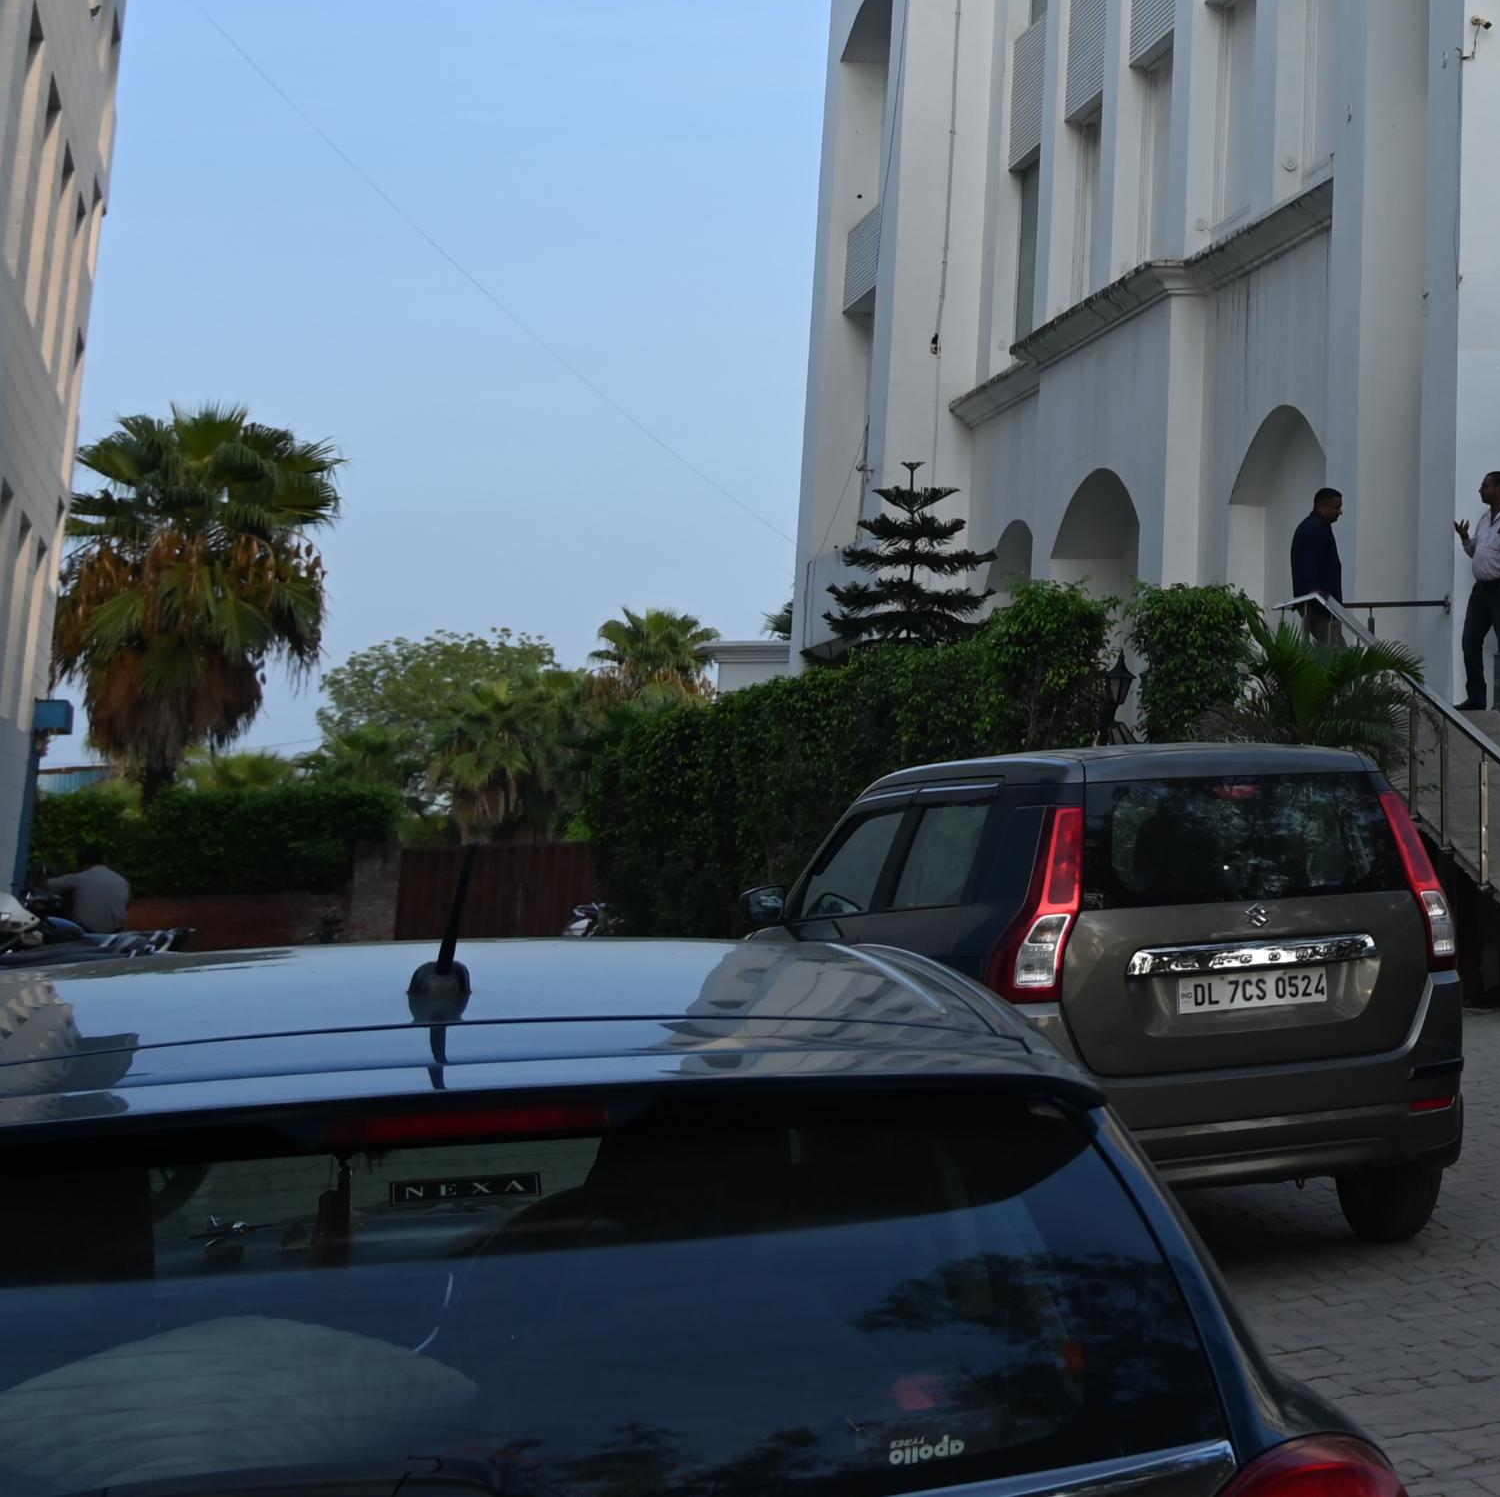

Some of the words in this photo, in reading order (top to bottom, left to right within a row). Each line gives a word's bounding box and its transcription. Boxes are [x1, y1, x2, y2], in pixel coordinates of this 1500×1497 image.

[1194, 983, 1220, 1007] DL
[1228, 978, 1267, 1003] 7CS
[1275, 973, 1326, 999] 0524
[405, 1179, 526, 1199] NEXA
[888, 1434, 965, 1465] apollo
